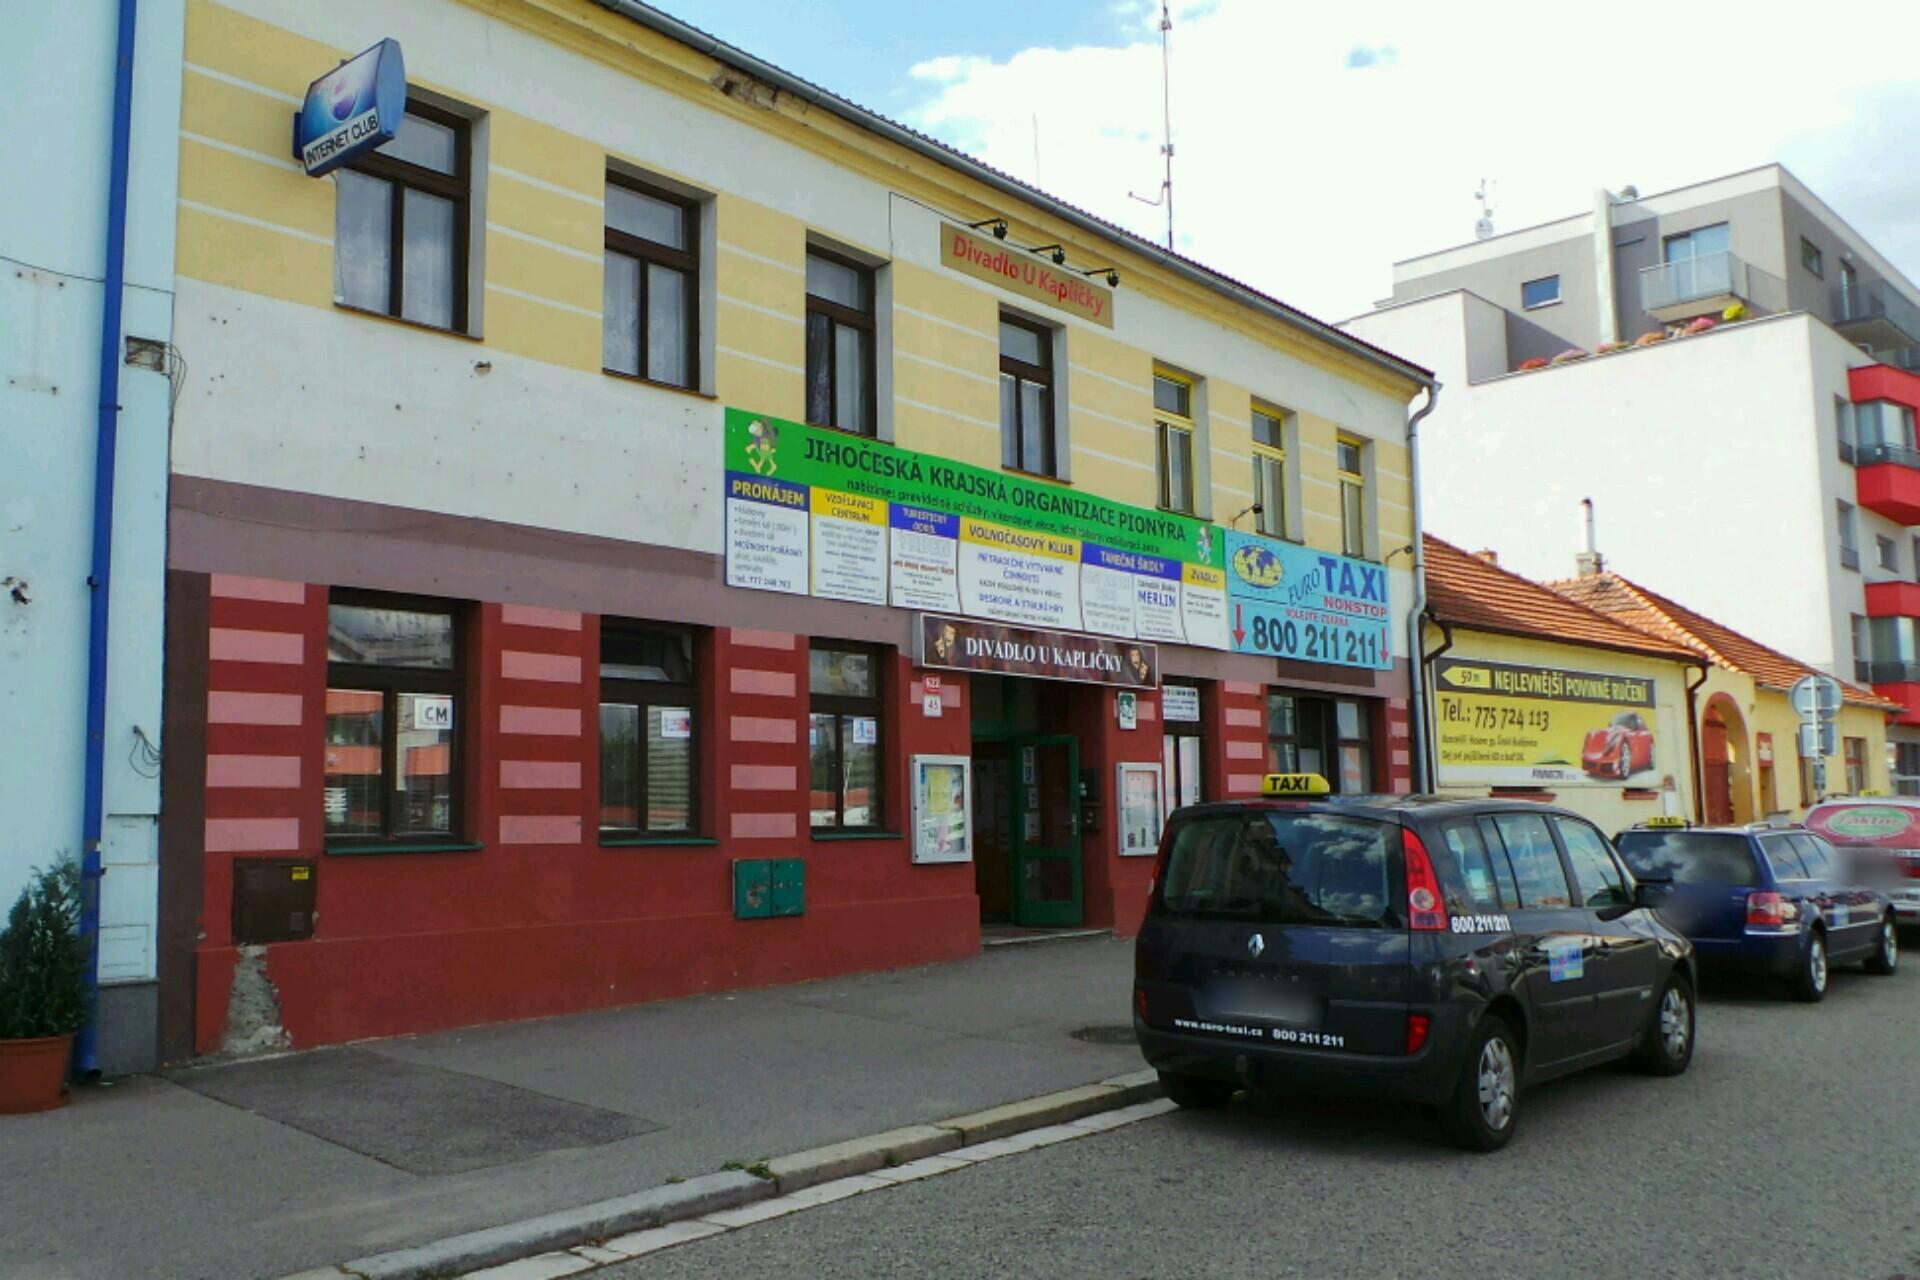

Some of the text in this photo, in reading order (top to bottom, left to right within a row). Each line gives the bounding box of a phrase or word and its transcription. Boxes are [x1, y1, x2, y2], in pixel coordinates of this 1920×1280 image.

[305, 114, 378, 166] INTERNET CLUB
[952, 234, 1104, 317] Divadlo U Kapličky
[732, 480, 805, 505] PRONÁJEM
[804, 437, 1186, 542] JIHOČESKÁ KRAJSKÁ ORGANIZACE PIONÝRA
[831, 507, 870, 523] CENTRUM
[969, 524, 1074, 555] VOLNOČASOVÝ KLUB
[1318, 556, 1388, 603] TAXI
[1137, 590, 1176, 607] MERLIN
[1323, 596, 1388, 617] NONSTOP
[1253, 615, 1376, 664] 800 211 211
[965, 637, 1123, 673] DIVADLO U KAPLIČKY
[1461, 671, 1472, 684] 50
[1494, 670, 1647, 701] NEJLEVNĚJŠÍ POVINNÉ RUČENÍ
[1441, 698, 1549, 731] Tel.: 775 724 113
[1270, 776, 1311, 791] TAXI
[1653, 817, 1677, 825] TAXI
[1451, 914, 1511, 933] 800 211 211
[1272, 1028, 1297, 1042] 800
[1299, 1032, 1321, 1044] 211
[1322, 1034, 1345, 1048] 211
